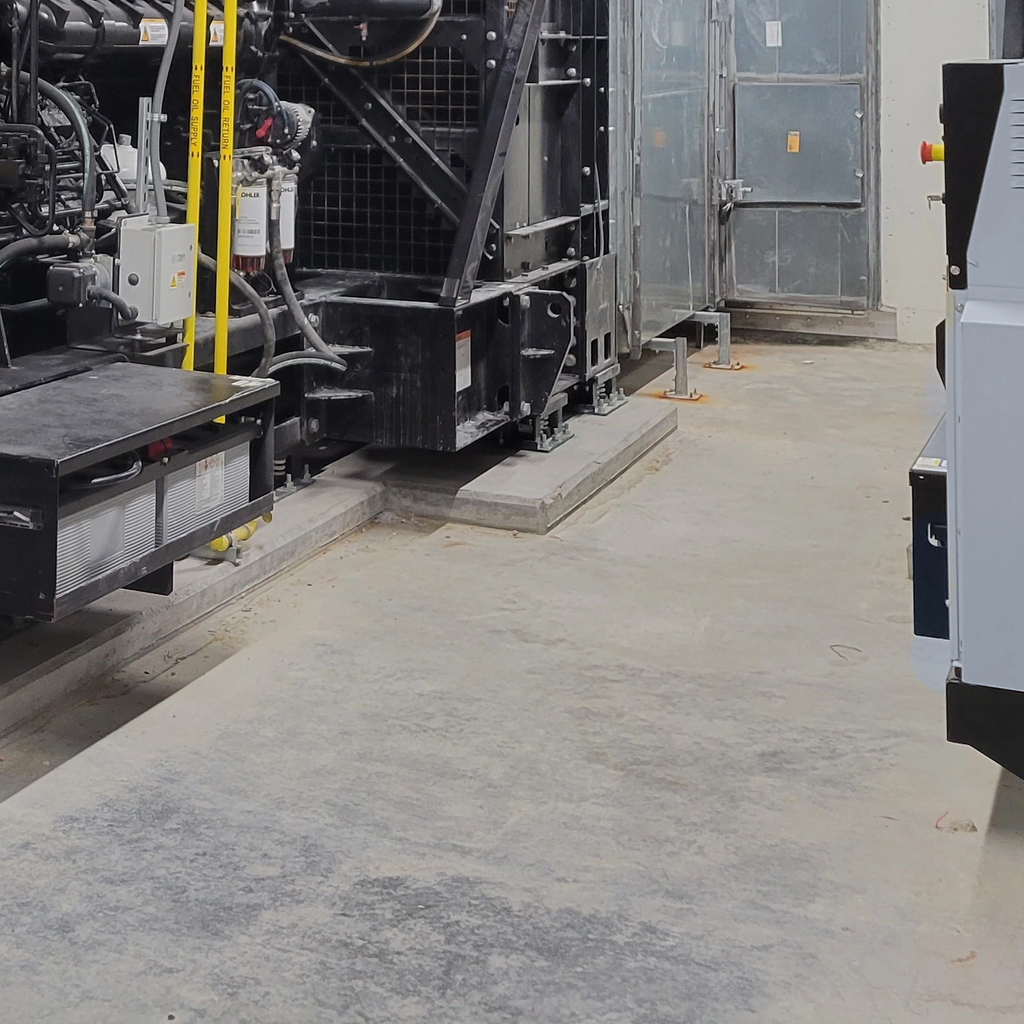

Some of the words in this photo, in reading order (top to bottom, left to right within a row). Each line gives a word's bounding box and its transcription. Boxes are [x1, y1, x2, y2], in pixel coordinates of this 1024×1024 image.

[192, 74, 200, 95] FUEL
[223, 75, 231, 95] FUEL
[191, 98, 199, 112] OIL
[222, 99, 230, 113] OIL
[190, 116, 198, 147] SUPPLY
[221, 117, 230, 150] RETURN
